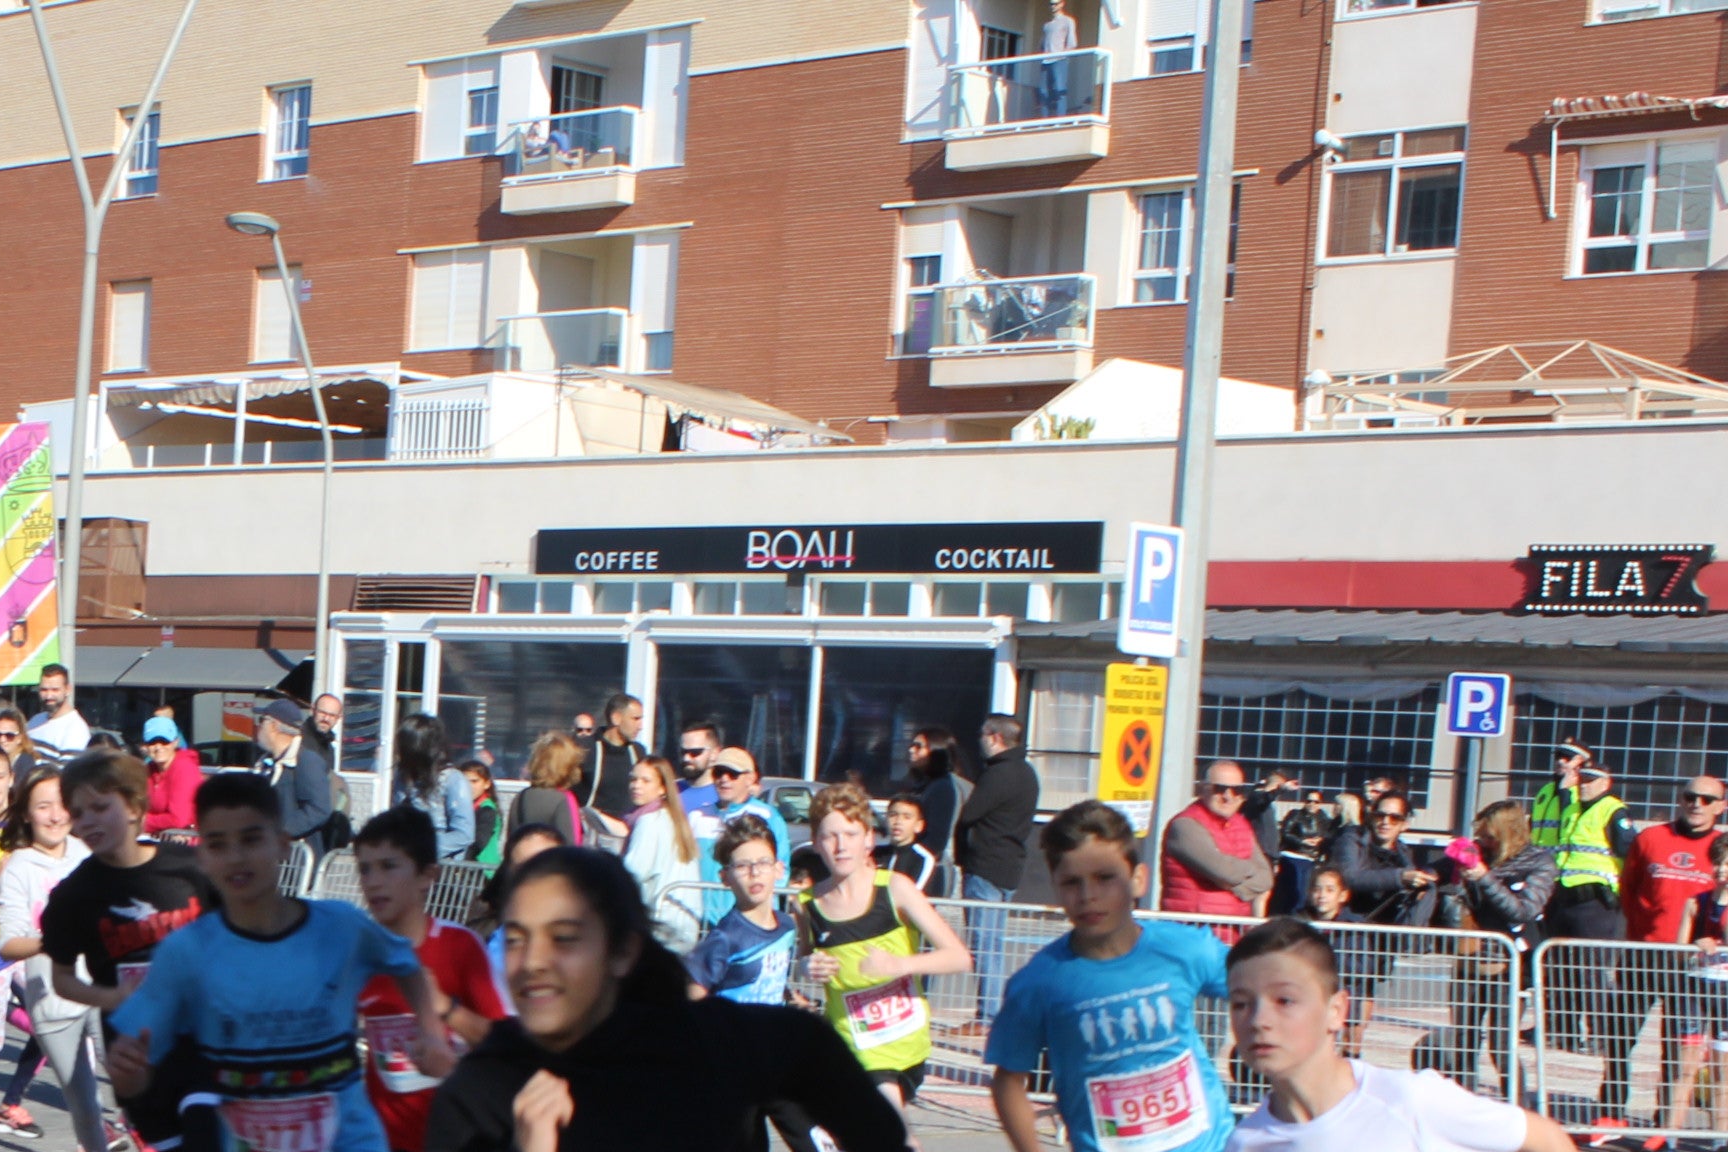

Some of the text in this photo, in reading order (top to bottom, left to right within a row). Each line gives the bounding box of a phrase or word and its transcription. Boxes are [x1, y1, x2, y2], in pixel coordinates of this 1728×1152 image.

[574, 551, 659, 571] COFFEE
[934, 548, 1055, 570] COCKTAIL
[1139, 536, 1173, 603] P
[1540, 554, 1692, 598] FILA 7
[1456, 680, 1495, 728] P
[869, 995, 905, 1020] 974
[1122, 1087, 1180, 1123] 965
